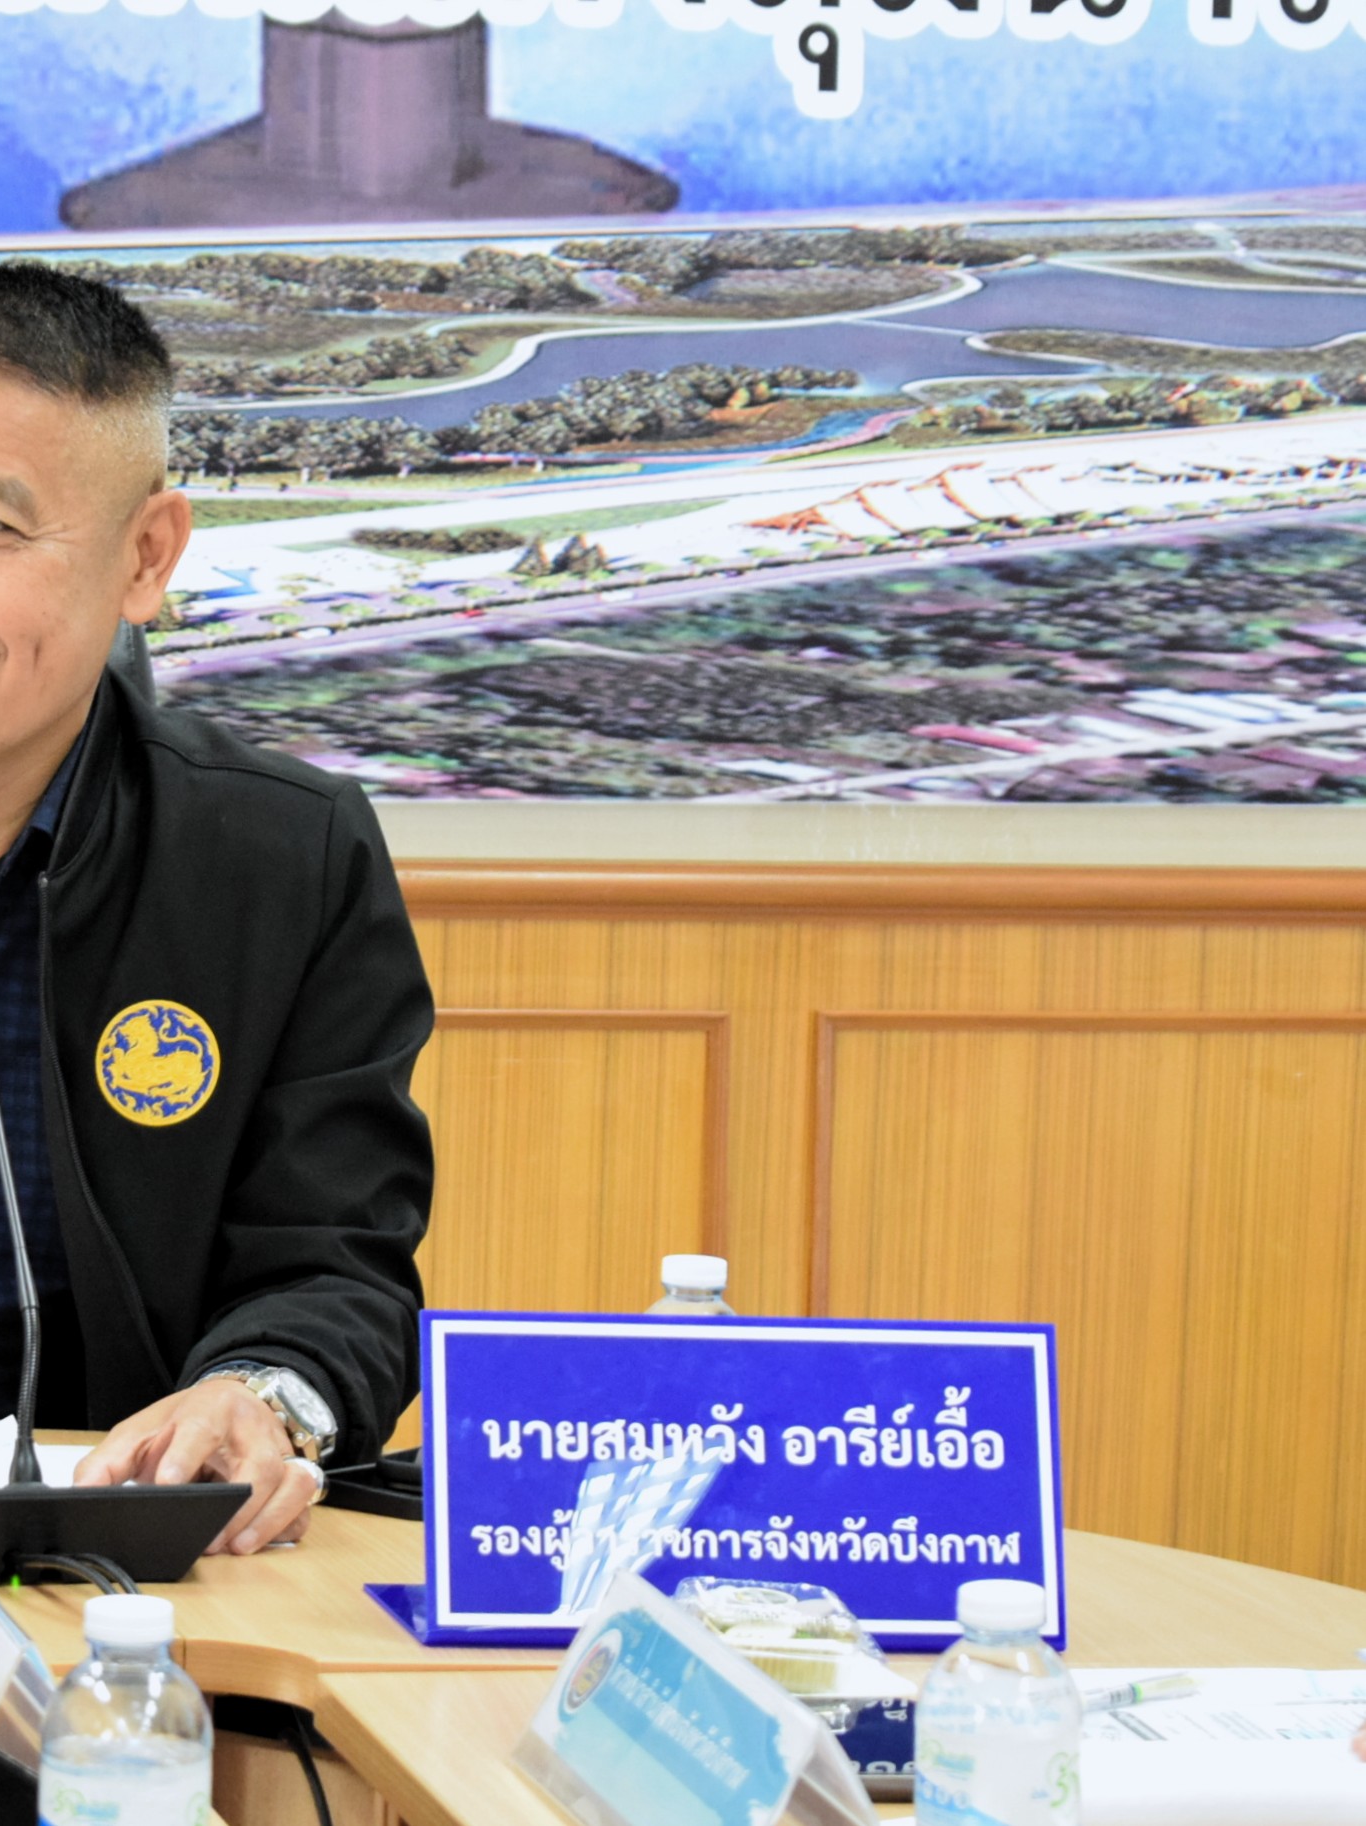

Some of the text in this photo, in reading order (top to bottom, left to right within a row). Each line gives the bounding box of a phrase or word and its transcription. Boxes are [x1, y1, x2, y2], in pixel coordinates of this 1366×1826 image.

[482, 1385, 1005, 1469] นายสมหวัง อารีย์เอื้อ
